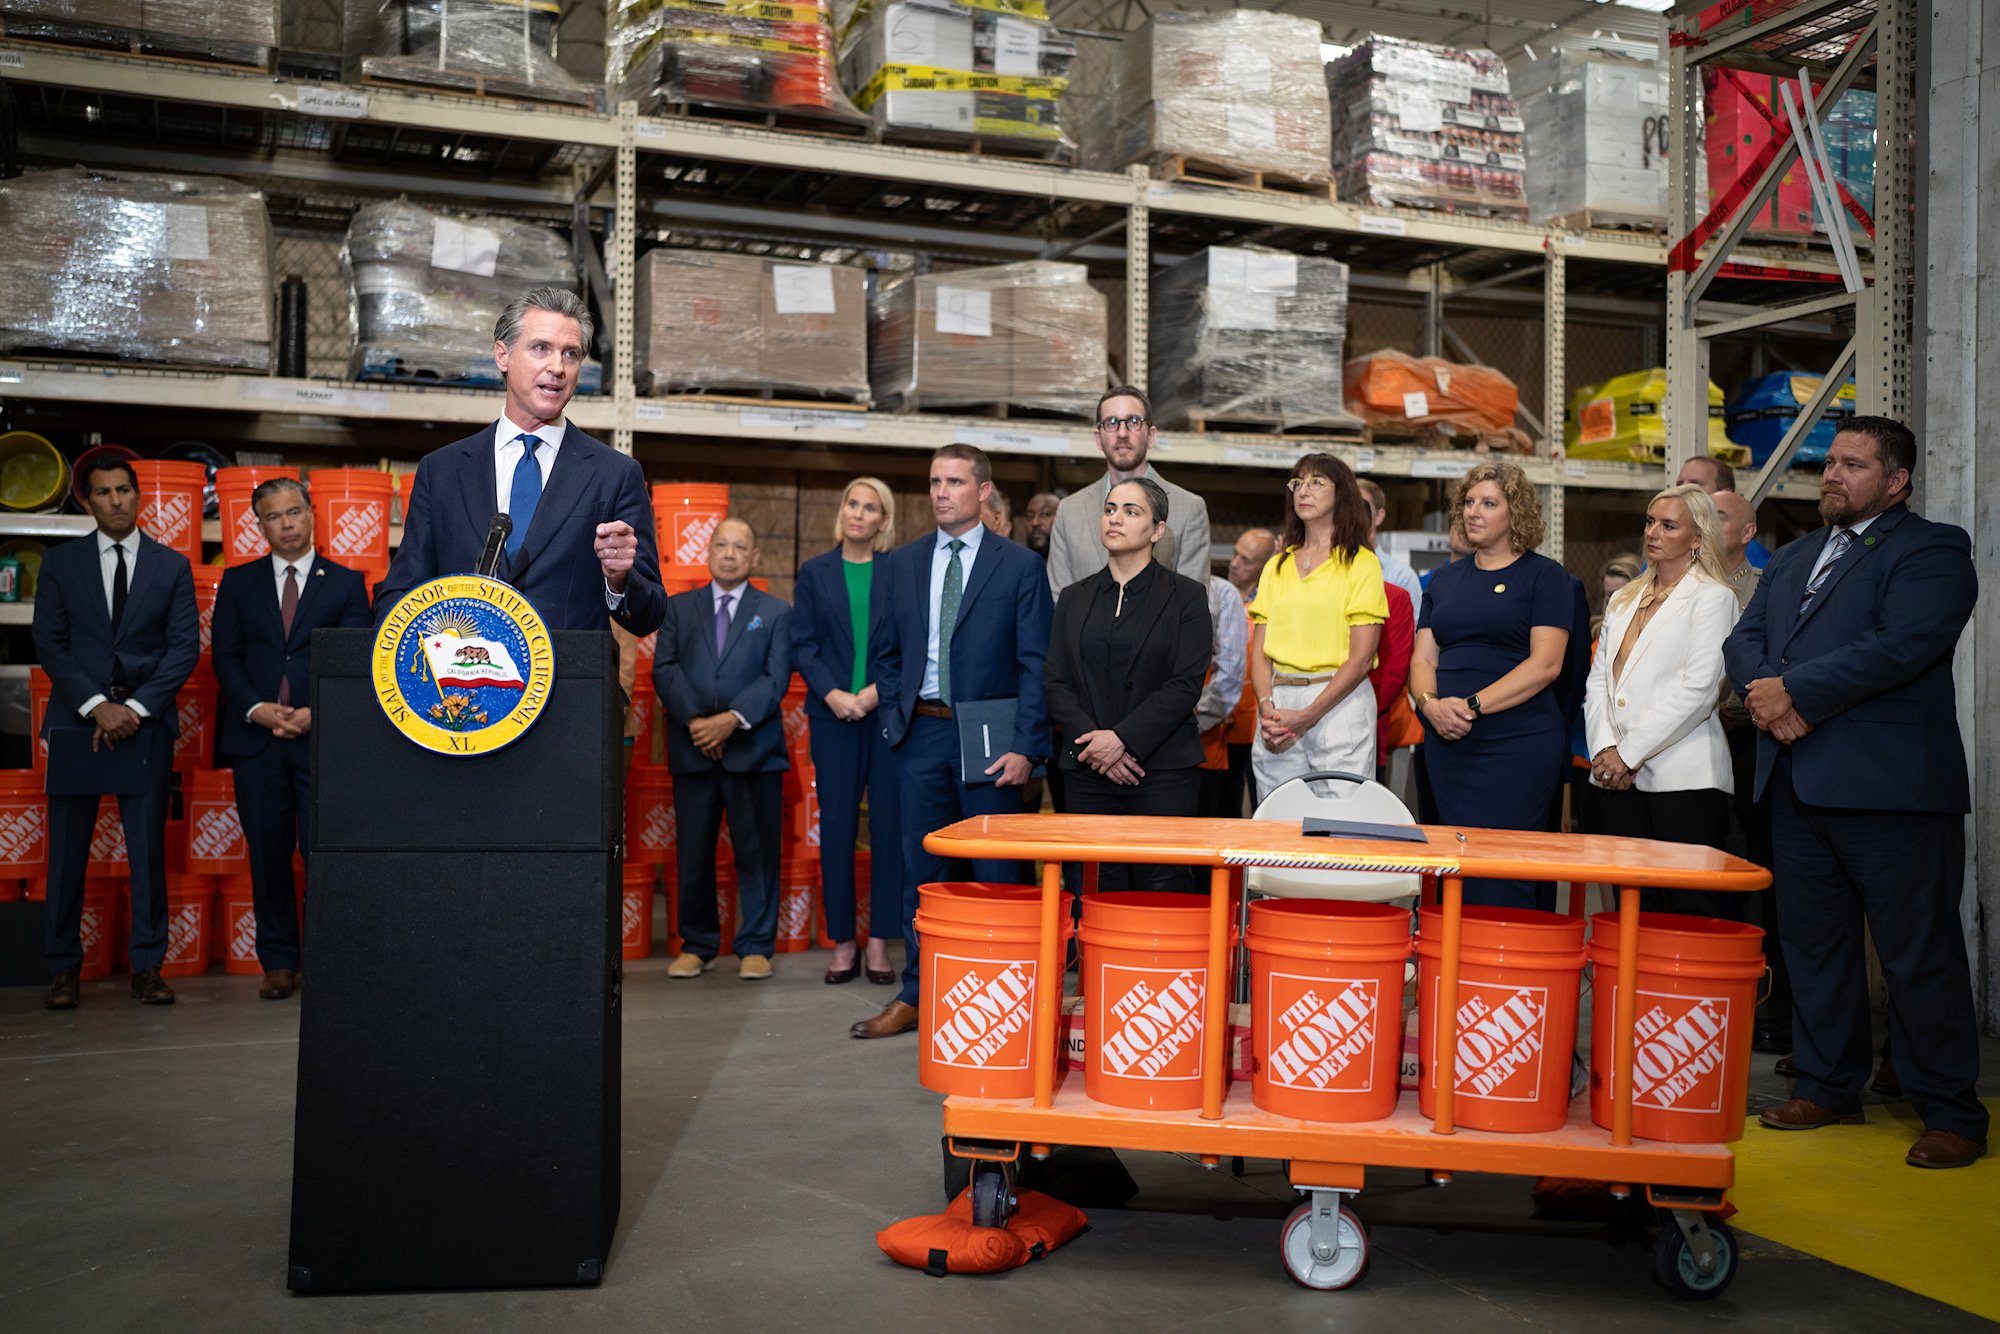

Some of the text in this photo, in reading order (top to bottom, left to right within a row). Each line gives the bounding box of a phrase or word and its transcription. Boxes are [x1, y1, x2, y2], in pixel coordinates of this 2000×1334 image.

[759, 5, 793, 17] CAUTION
[1720, 0, 1749, 17] PELIG
[968, 77, 998, 88] CAUTION
[296, 389, 334, 401] HAZMAT
[331, 501, 383, 554] HOME
[336, 505, 360, 528] THE
[681, 518, 702, 540] THE
[351, 523, 382, 555] DEPOT
[448, 584, 459, 593] OF
[460, 583, 478, 592] THE
[478, 582, 526, 617] STATE
[380, 583, 449, 651] GOVERNOR
[520, 612, 542, 635] OF
[379, 654, 389, 672] THE
[446, 667, 509, 678] CALIFORNIA REPUBLIC
[511, 634, 549, 727] CALIFORNIA
[380, 681, 411, 723] SEAL
[447, 736, 476, 751] XL
[196, 808, 221, 832] THE
[231, 922, 257, 960] HO
[941, 970, 985, 1011] THE
[1110, 979, 1155, 1023] THE
[1278, 989, 1325, 1033] THE
[933, 962, 1034, 1063] HOME
[1103, 970, 1204, 1075] HOME
[1269, 980, 1376, 1085] HOME
[1456, 995, 1490, 1036] HE
[1634, 1005, 1672, 1048] HE
[966, 1001, 1030, 1067] DEPOT
[1138, 1010, 1202, 1078] DEPOT
[1306, 1021, 1373, 1089] DEPOT
[1471, 1030, 1541, 1096] DEPOT
[1652, 1040, 1723, 1109] DEPOT
